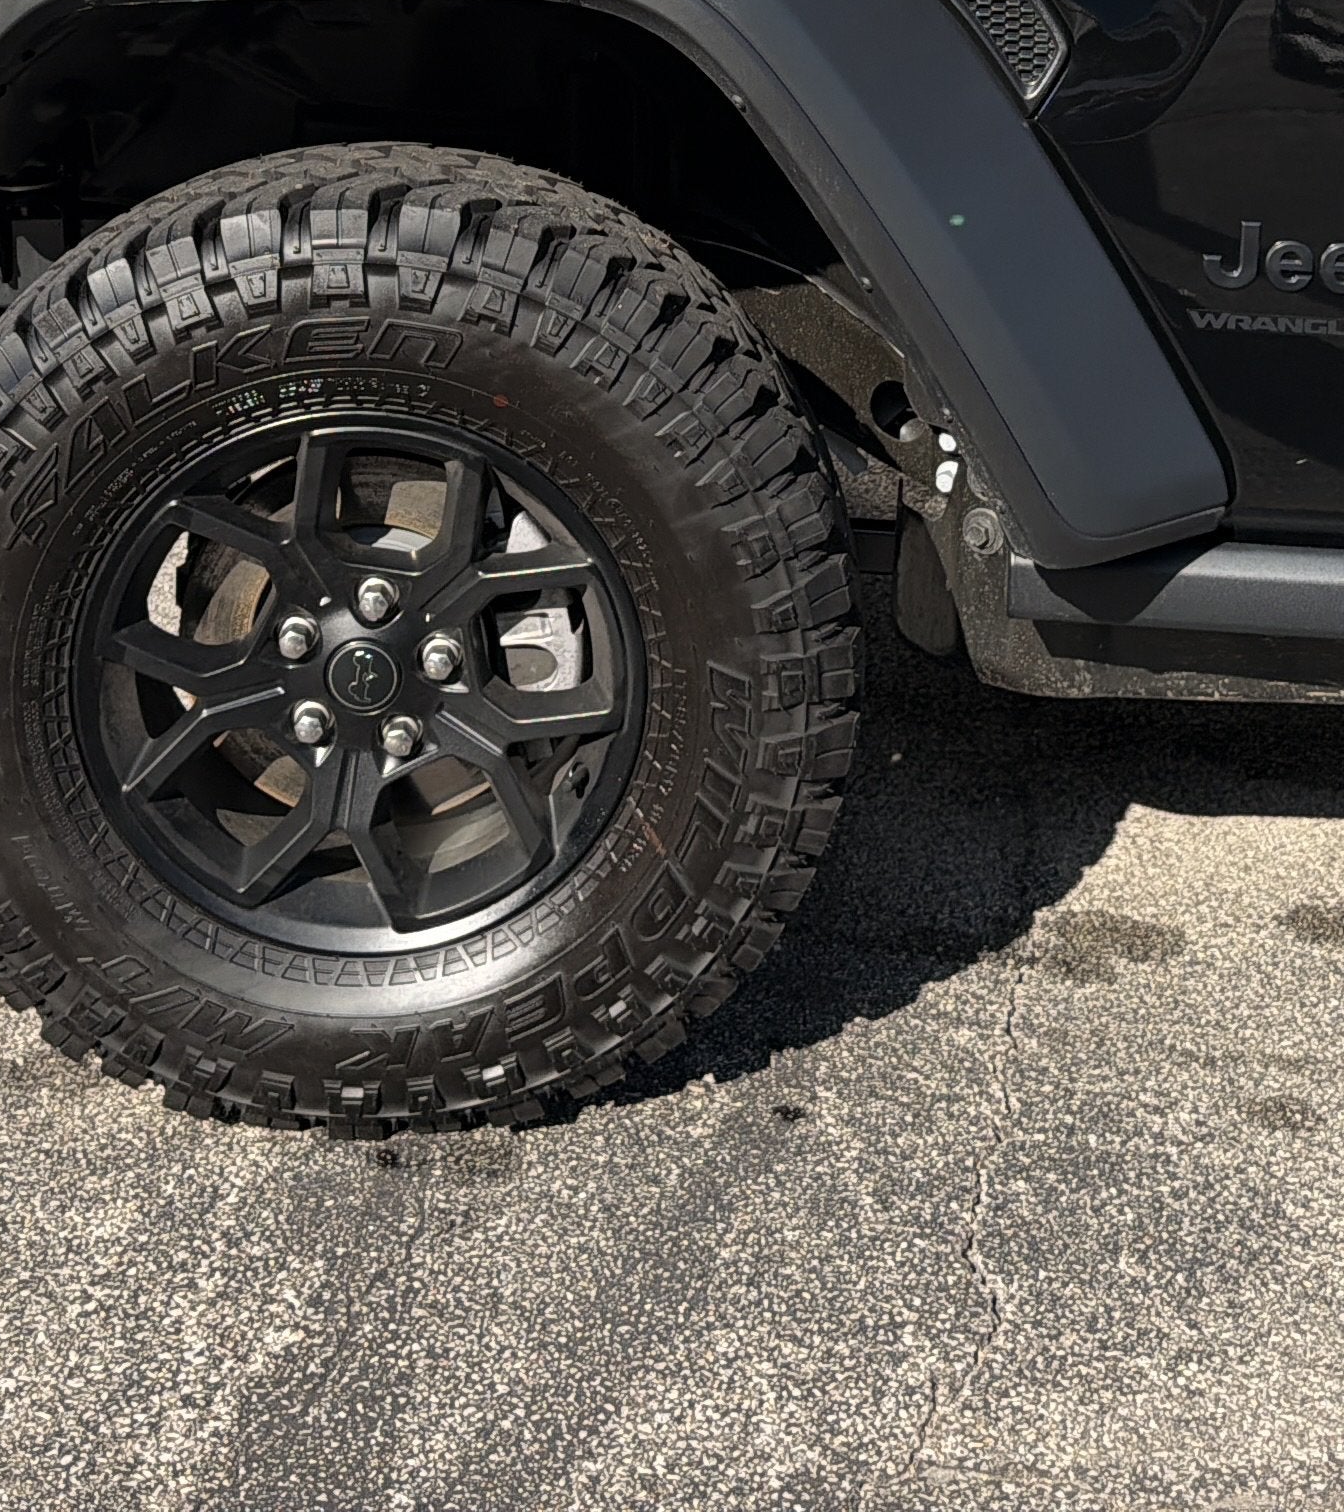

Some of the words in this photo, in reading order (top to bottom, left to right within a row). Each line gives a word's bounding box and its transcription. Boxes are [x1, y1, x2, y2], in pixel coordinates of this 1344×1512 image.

[6, 316, 464, 550] FALKEN
[334, 660, 754, 1070] WILDPEAK
[77, 954, 296, 1055] M/T
